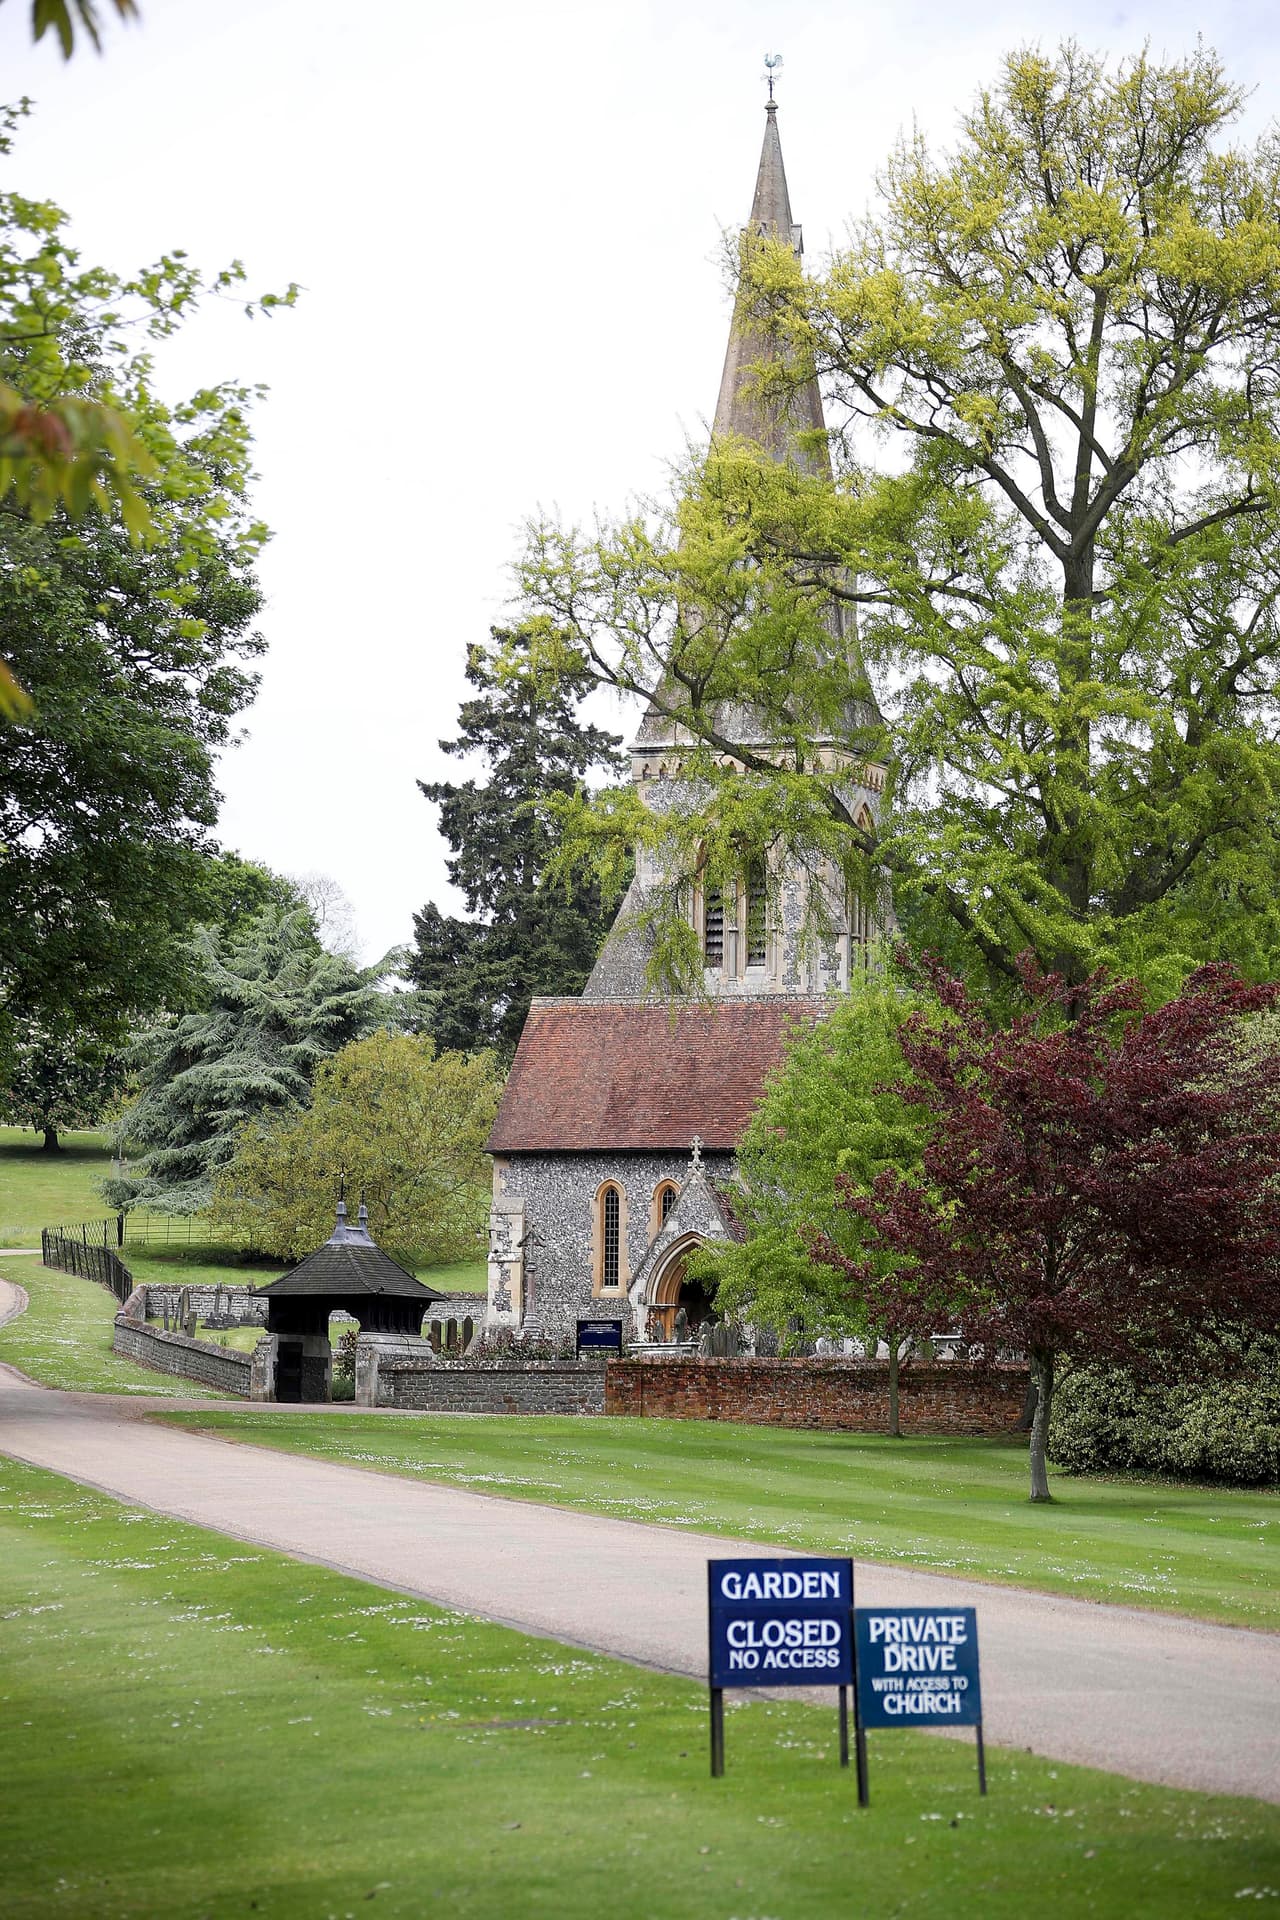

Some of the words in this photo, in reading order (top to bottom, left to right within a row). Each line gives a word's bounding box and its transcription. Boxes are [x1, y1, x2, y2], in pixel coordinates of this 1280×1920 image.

[721, 1572, 841, 1600] GARDEN
[726, 1620, 842, 1648] CLOSED
[869, 1616, 967, 1645] PRIVATE
[729, 1650, 759, 1669] NO
[762, 1649, 840, 1669] ACCESS
[883, 1644, 957, 1673] DRIVE
[872, 1677, 904, 1692] WITH
[906, 1677, 949, 1691] ACCESS
[952, 1676, 968, 1691] TO
[883, 1692, 961, 1715] CHURCH
